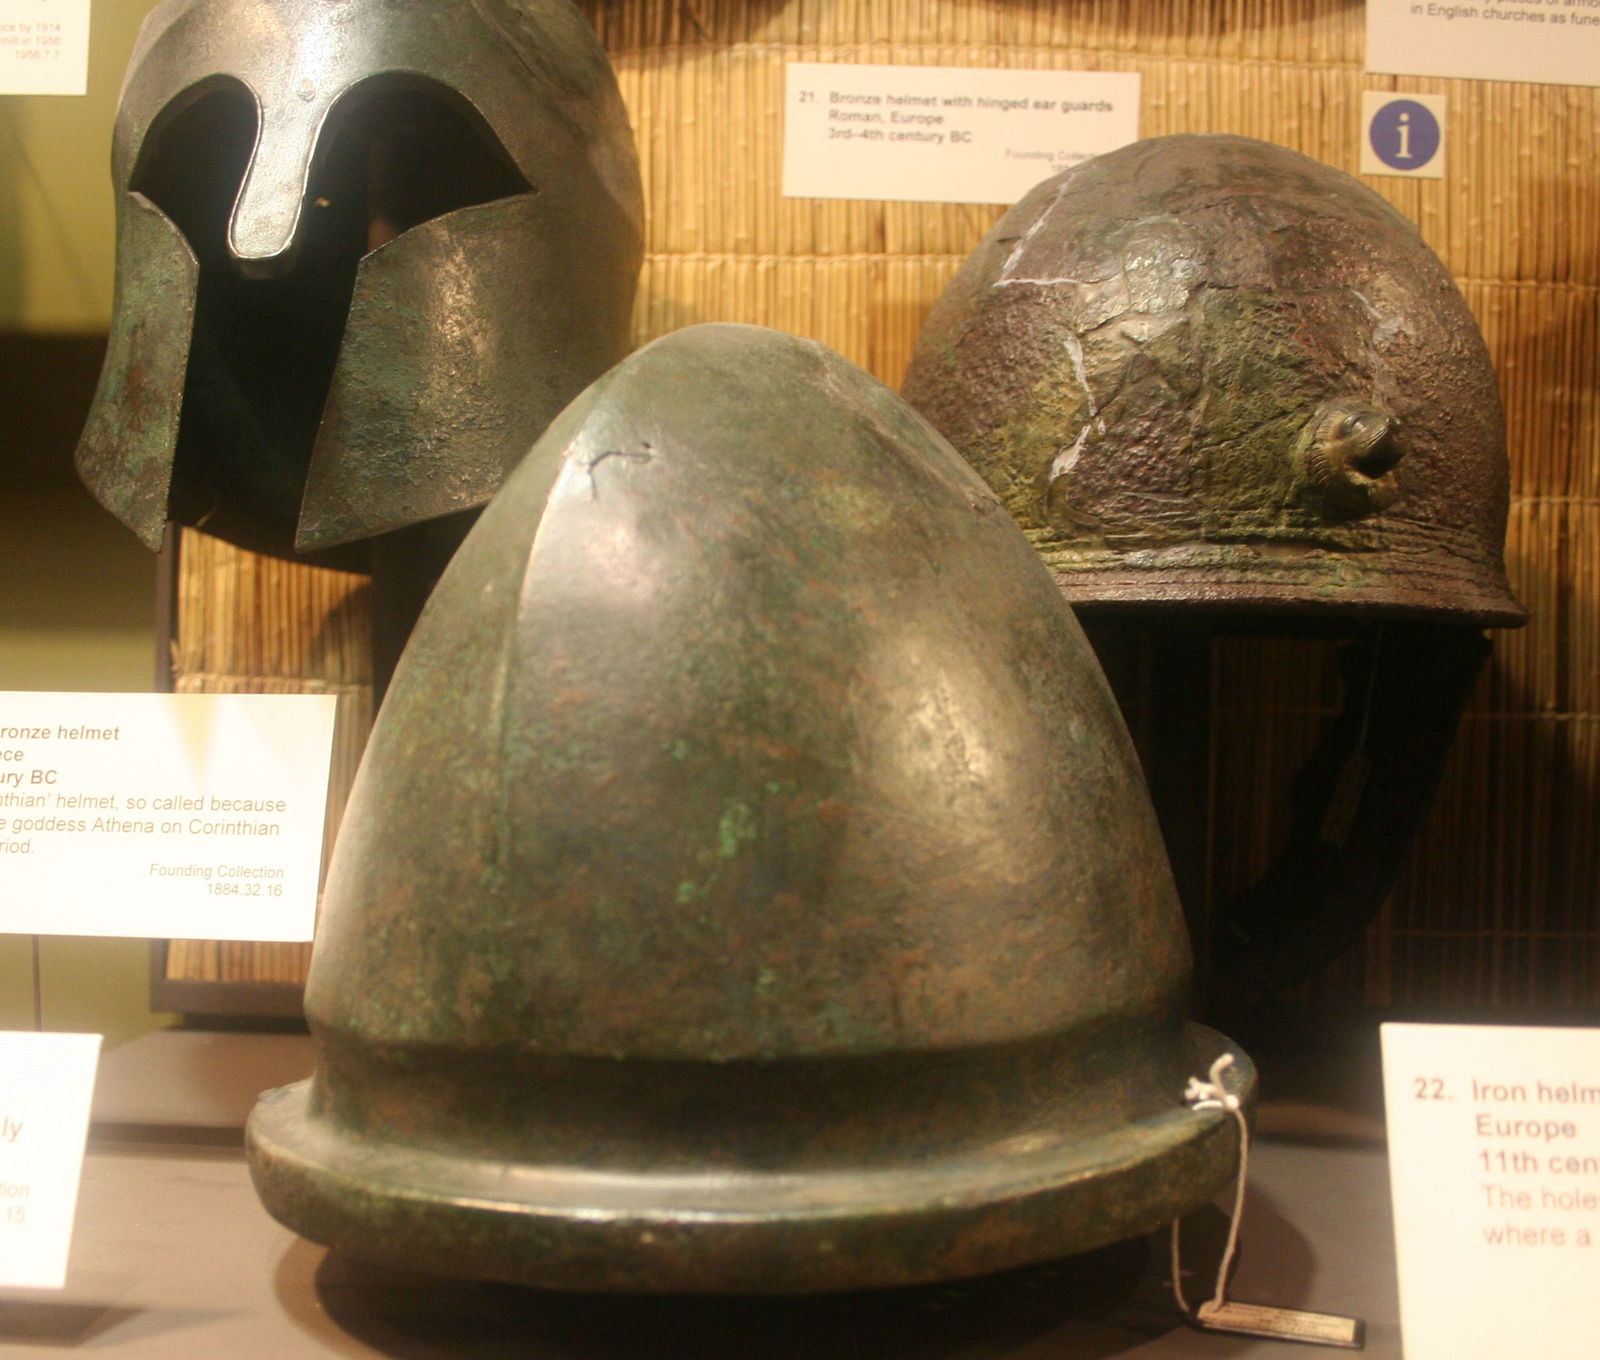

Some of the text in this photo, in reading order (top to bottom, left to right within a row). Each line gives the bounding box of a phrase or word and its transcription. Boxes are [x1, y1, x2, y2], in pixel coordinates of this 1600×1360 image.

[1410, 4, 1422, 14] in
[1427, 3, 1478, 19] English
[1483, 8, 1545, 23] churches
[1550, 13, 1566, 24] as
[829, 91, 881, 104] Bronze
[887, 94, 937, 106] helmet
[943, 96, 972, 107] with
[977, 97, 1028, 111] hinged
[1033, 100, 1056, 110] ear
[1061, 100, 1114, 113] guards
[828, 109, 944, 125] Roman, Europe
[889, 130, 944, 144] century
[950, 130, 972, 143] BC
[1004, 148, 1055, 161] Founding
[57, 725, 120, 741] helmet
[30, 769, 58, 785] BC
[57, 793, 119, 811] helmet,
[126, 797, 147, 810] so
[152, 796, 204, 811] called
[210, 796, 286, 812] because
[12, 816, 86, 834] goddess
[91, 817, 154, 833] Athena
[161, 821, 182, 834] on
[189, 818, 280, 835] Corinthian
[149, 863, 284, 880] Founding Collection
[207, 883, 282, 897] 1884.32.16
[1413, 1077, 1453, 1101] 22.
[1472, 1079, 1527, 1102] Iron
[1474, 1113, 1577, 1143] Europe
[1479, 1149, 1538, 1173] 11th
[1480, 1183, 1532, 1210] The
[1483, 1223, 1591, 1247] where a
